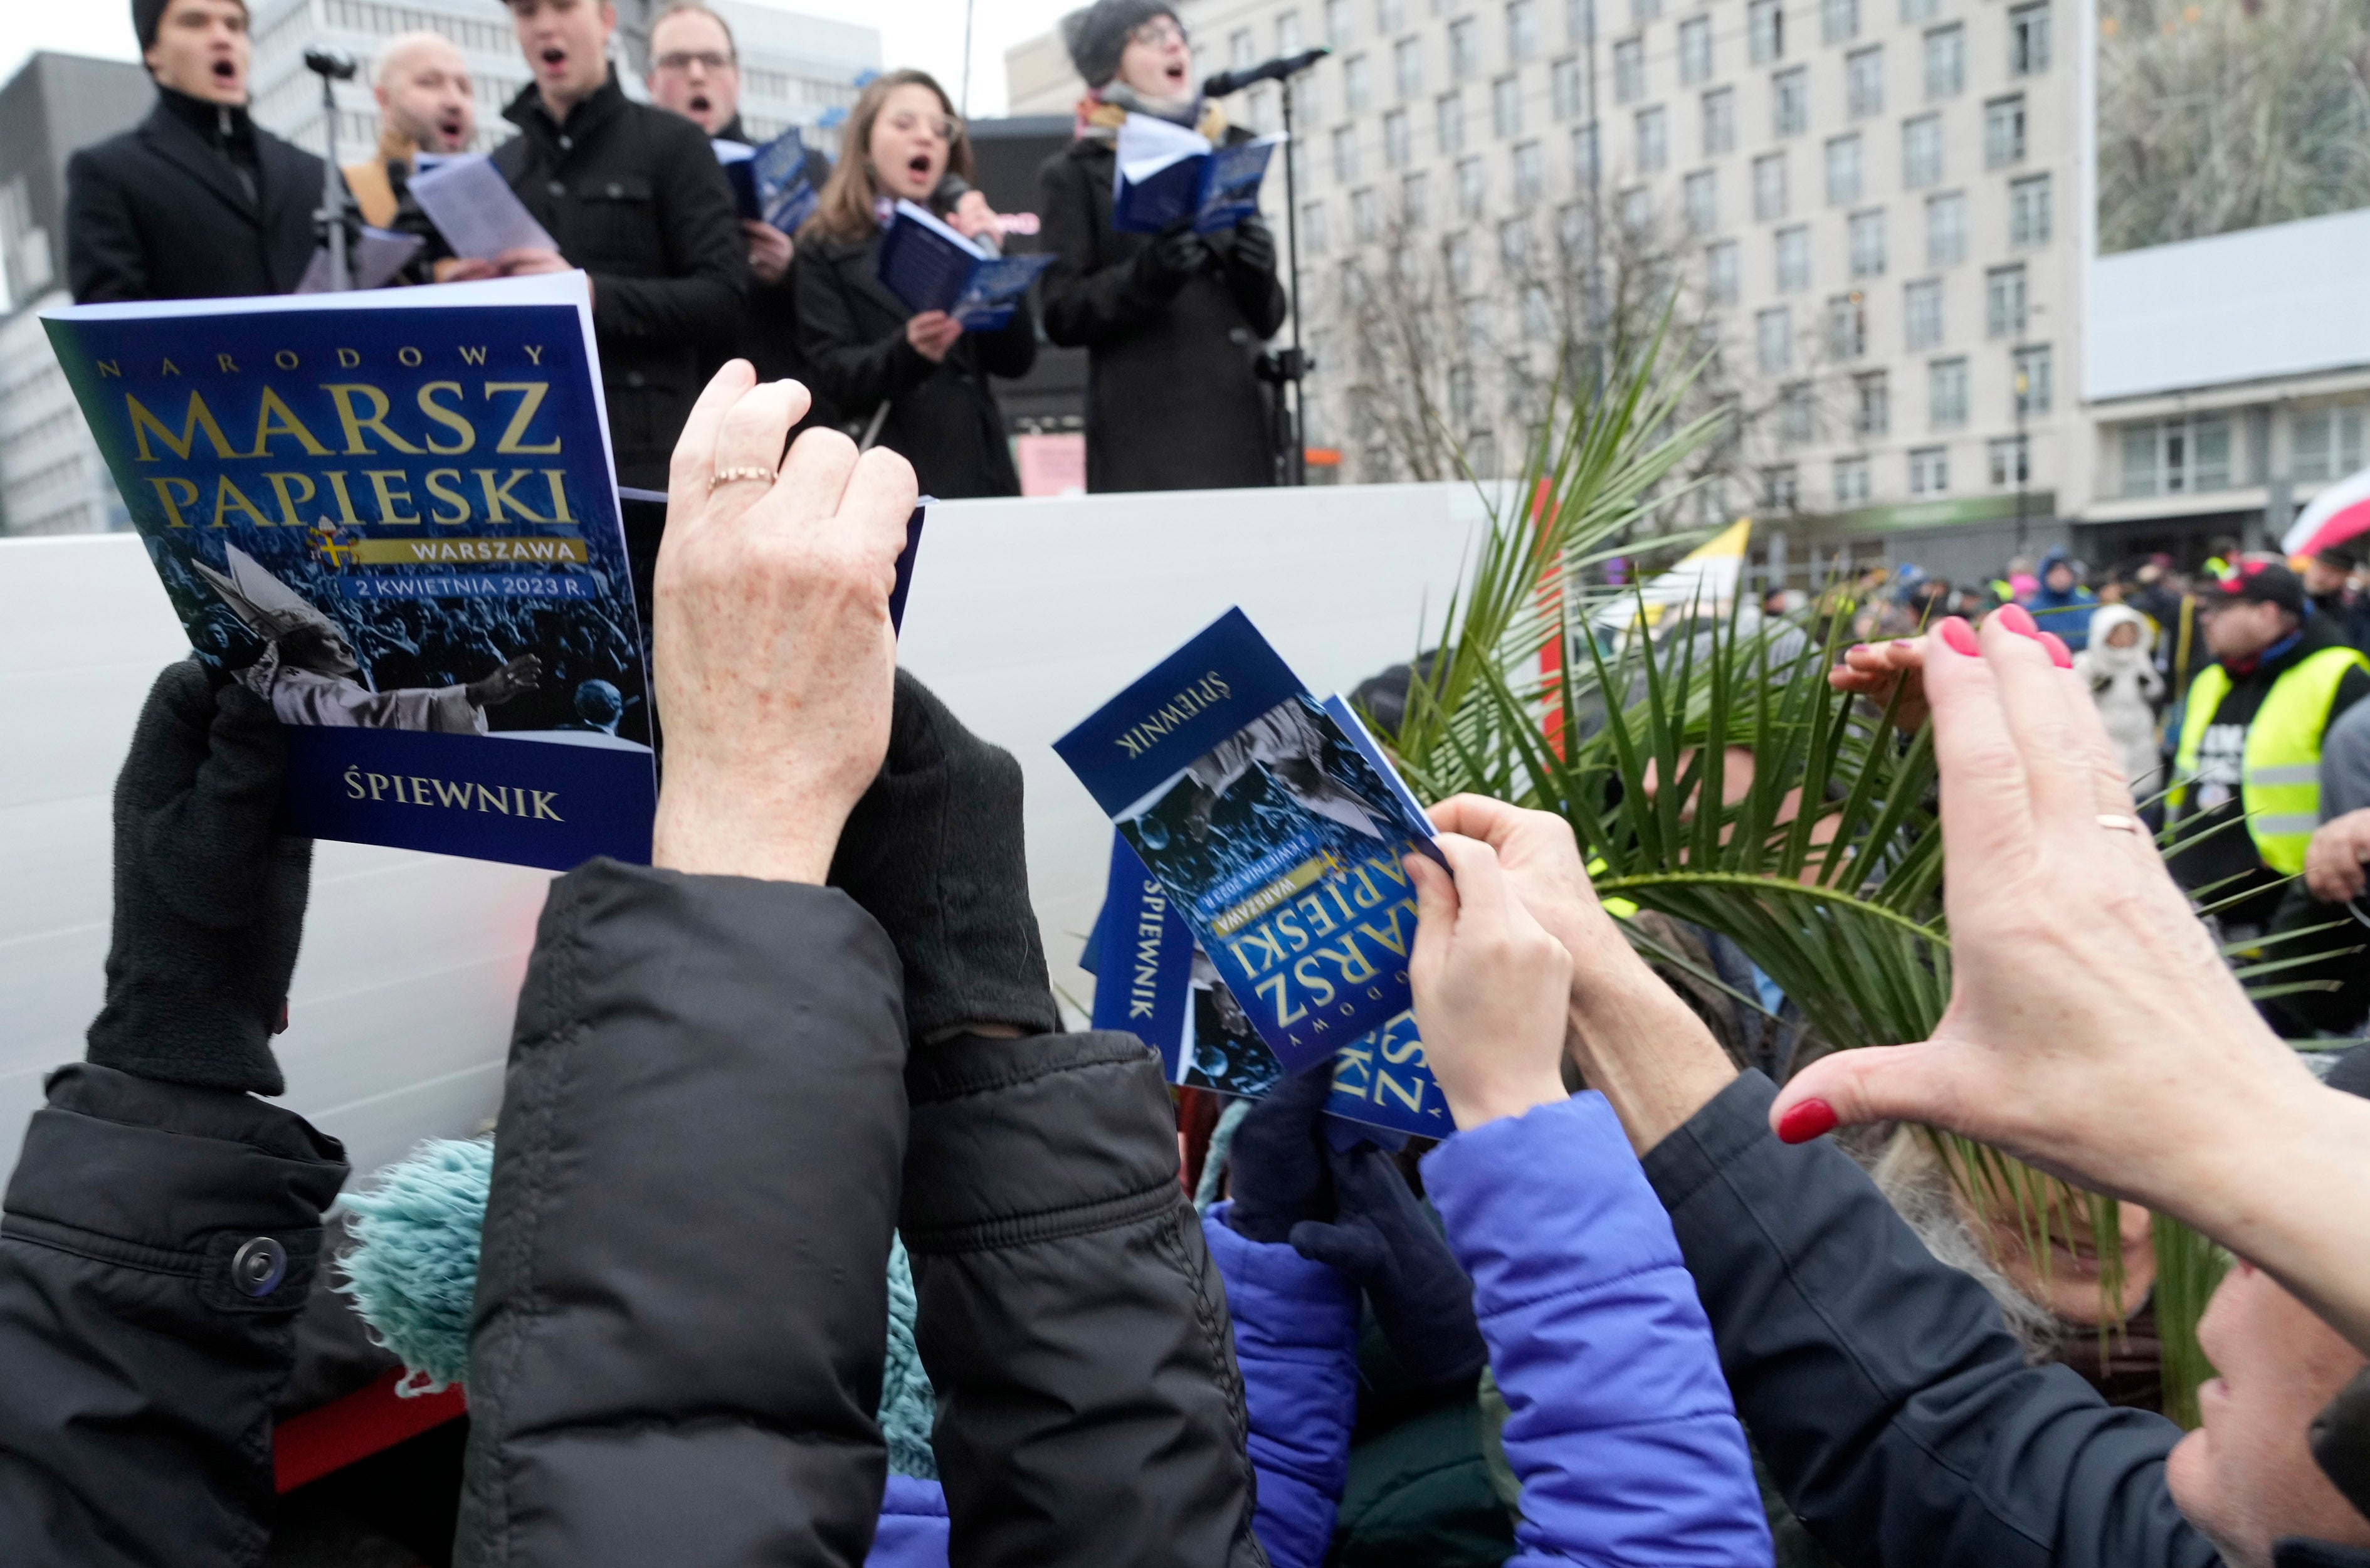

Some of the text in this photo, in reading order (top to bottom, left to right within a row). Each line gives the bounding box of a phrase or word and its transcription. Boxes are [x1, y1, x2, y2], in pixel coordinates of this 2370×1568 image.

[97, 345, 542, 377] NARODOWY
[126, 381, 561, 461] MARSZ
[144, 468, 579, 528] PAPIESKI
[411, 541, 575, 561] WARSZAWA
[356, 578, 587, 596] 2 KWIETNIA 2023 R.
[1114, 670, 1231, 760] ŚPIEWNIK
[344, 764, 566, 822] ŚPIEWNIK
[1216, 878, 1297, 932] WARSZAWA
[1227, 840, 1420, 980] APIESKI
[1255, 897, 1419, 1028] ARSZ
[1289, 970, 1409, 1047] ODOWY
